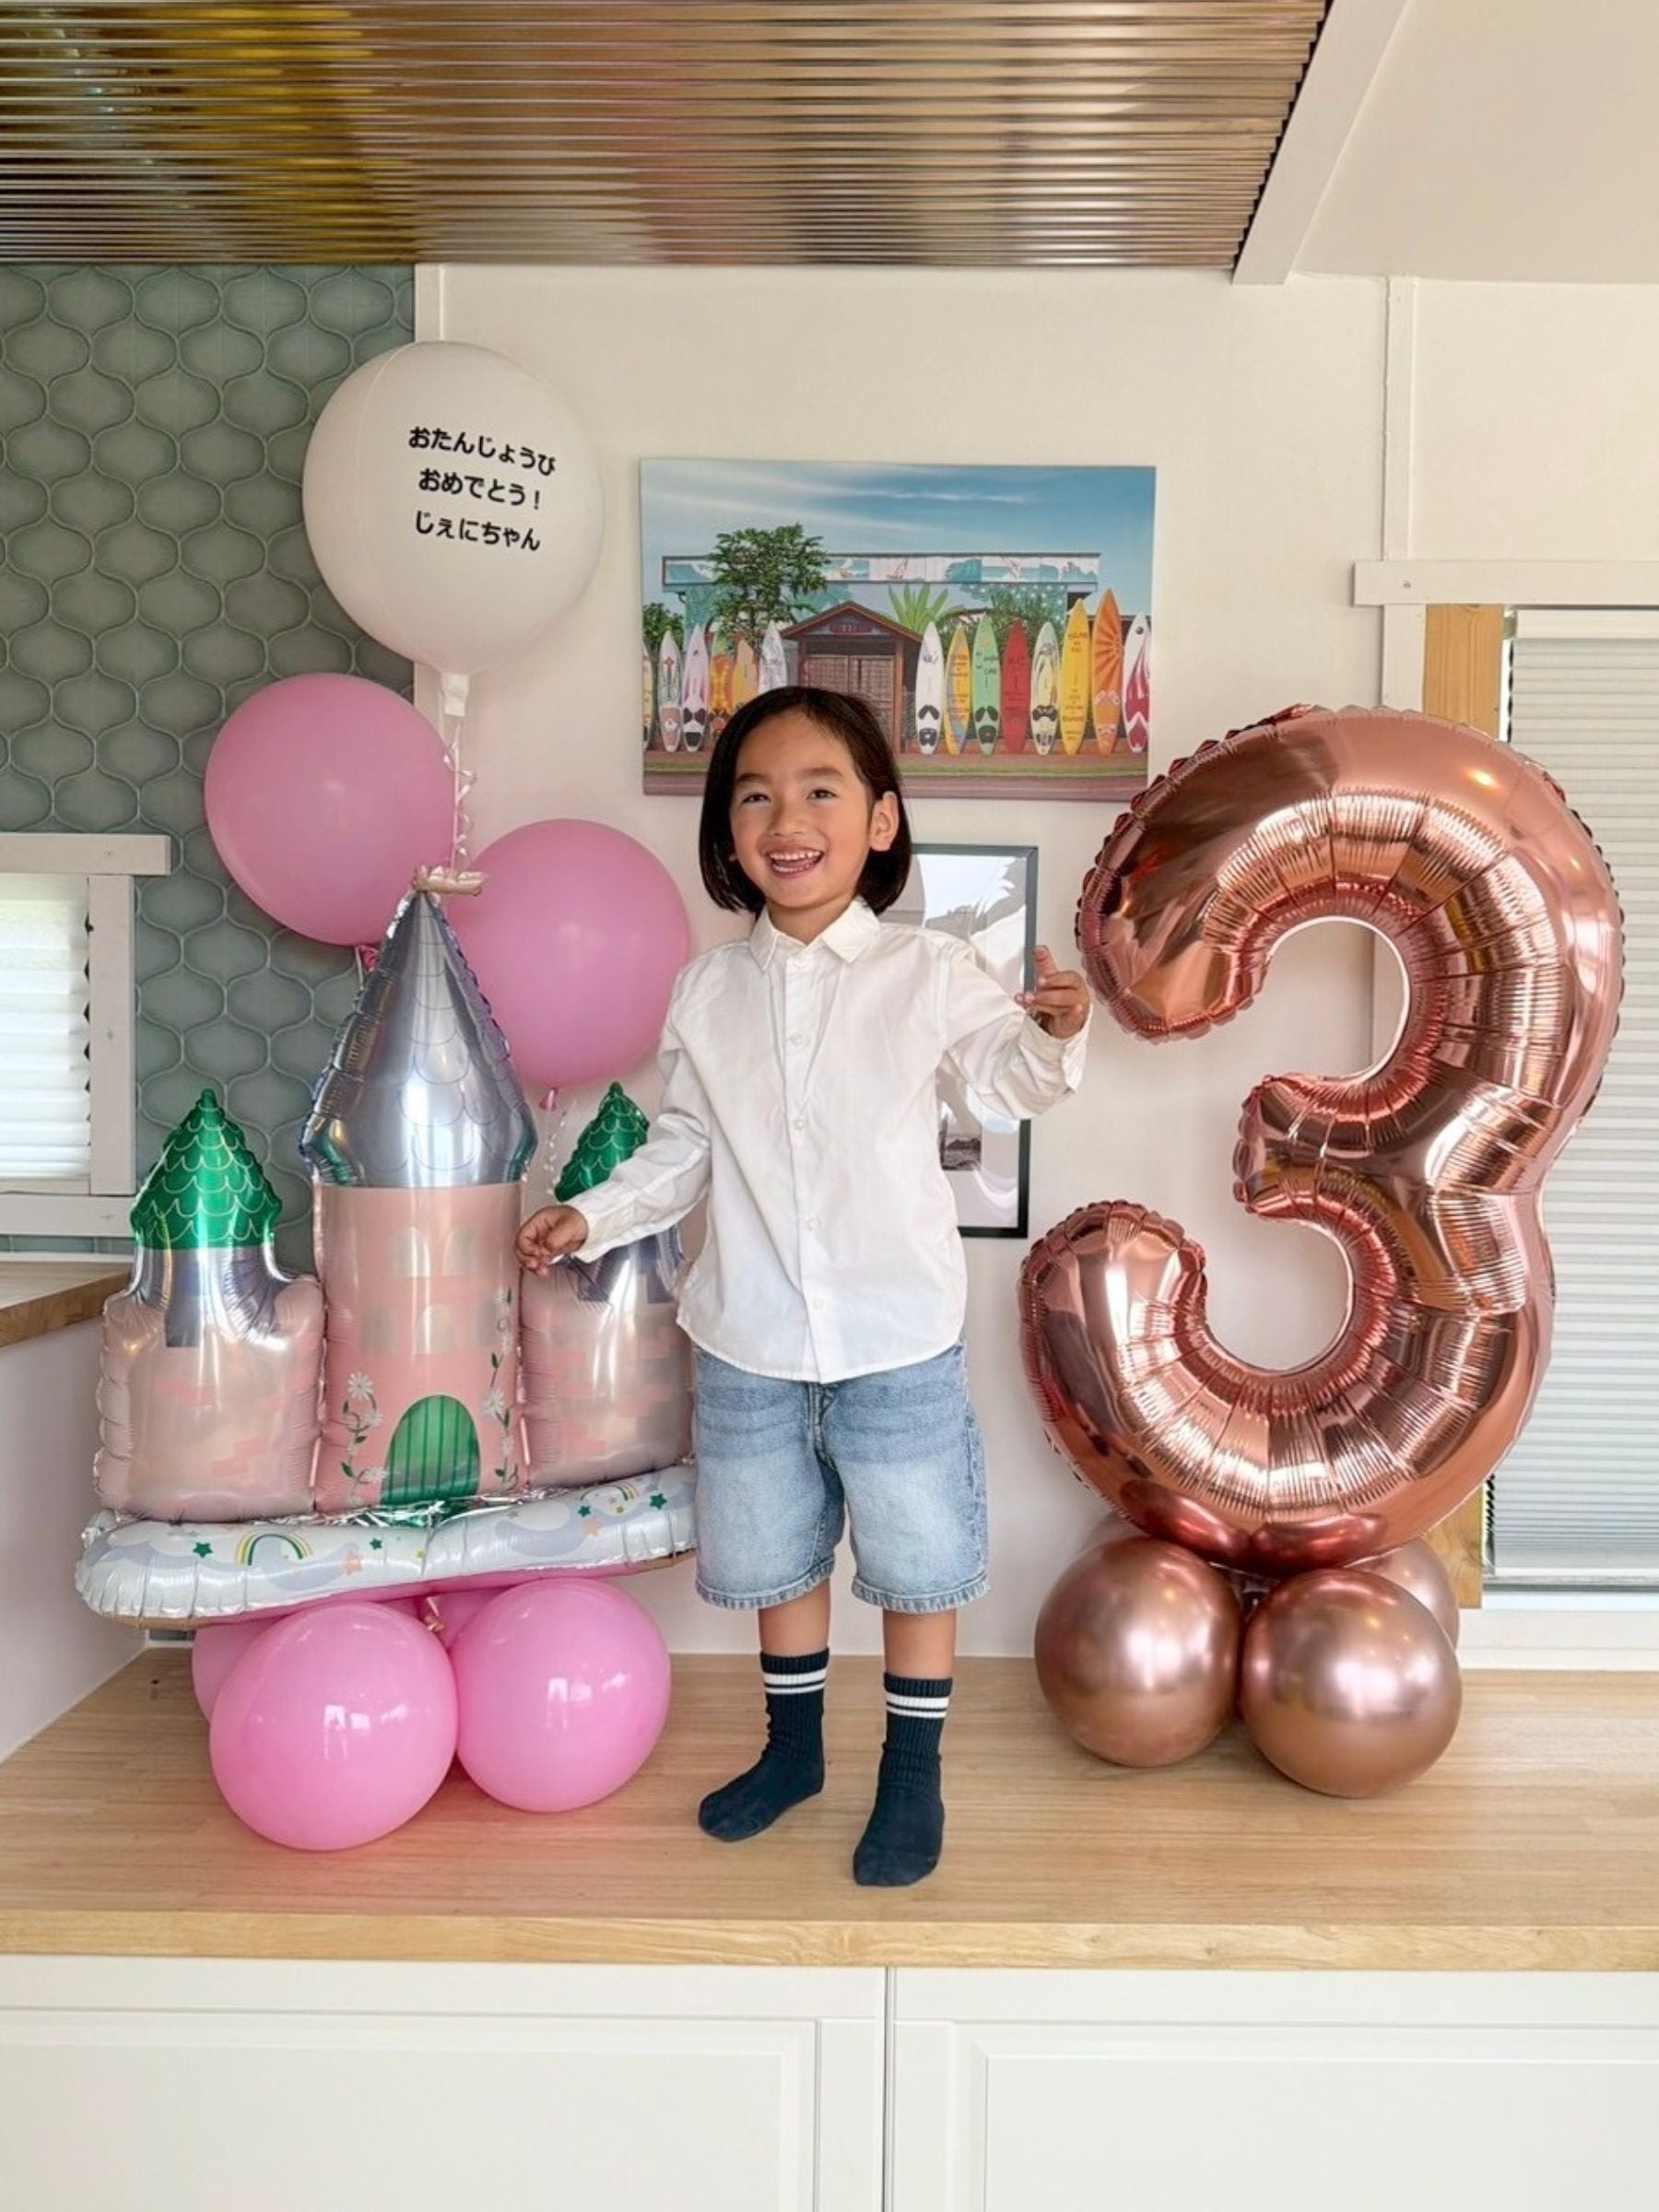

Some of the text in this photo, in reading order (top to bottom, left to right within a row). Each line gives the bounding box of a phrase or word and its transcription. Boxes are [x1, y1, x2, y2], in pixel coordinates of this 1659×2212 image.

[407, 426, 557, 477] おたんじょうび
[415, 510, 541, 551] じぇにちゃん
[1019, 705, 1625, 1573] 3
